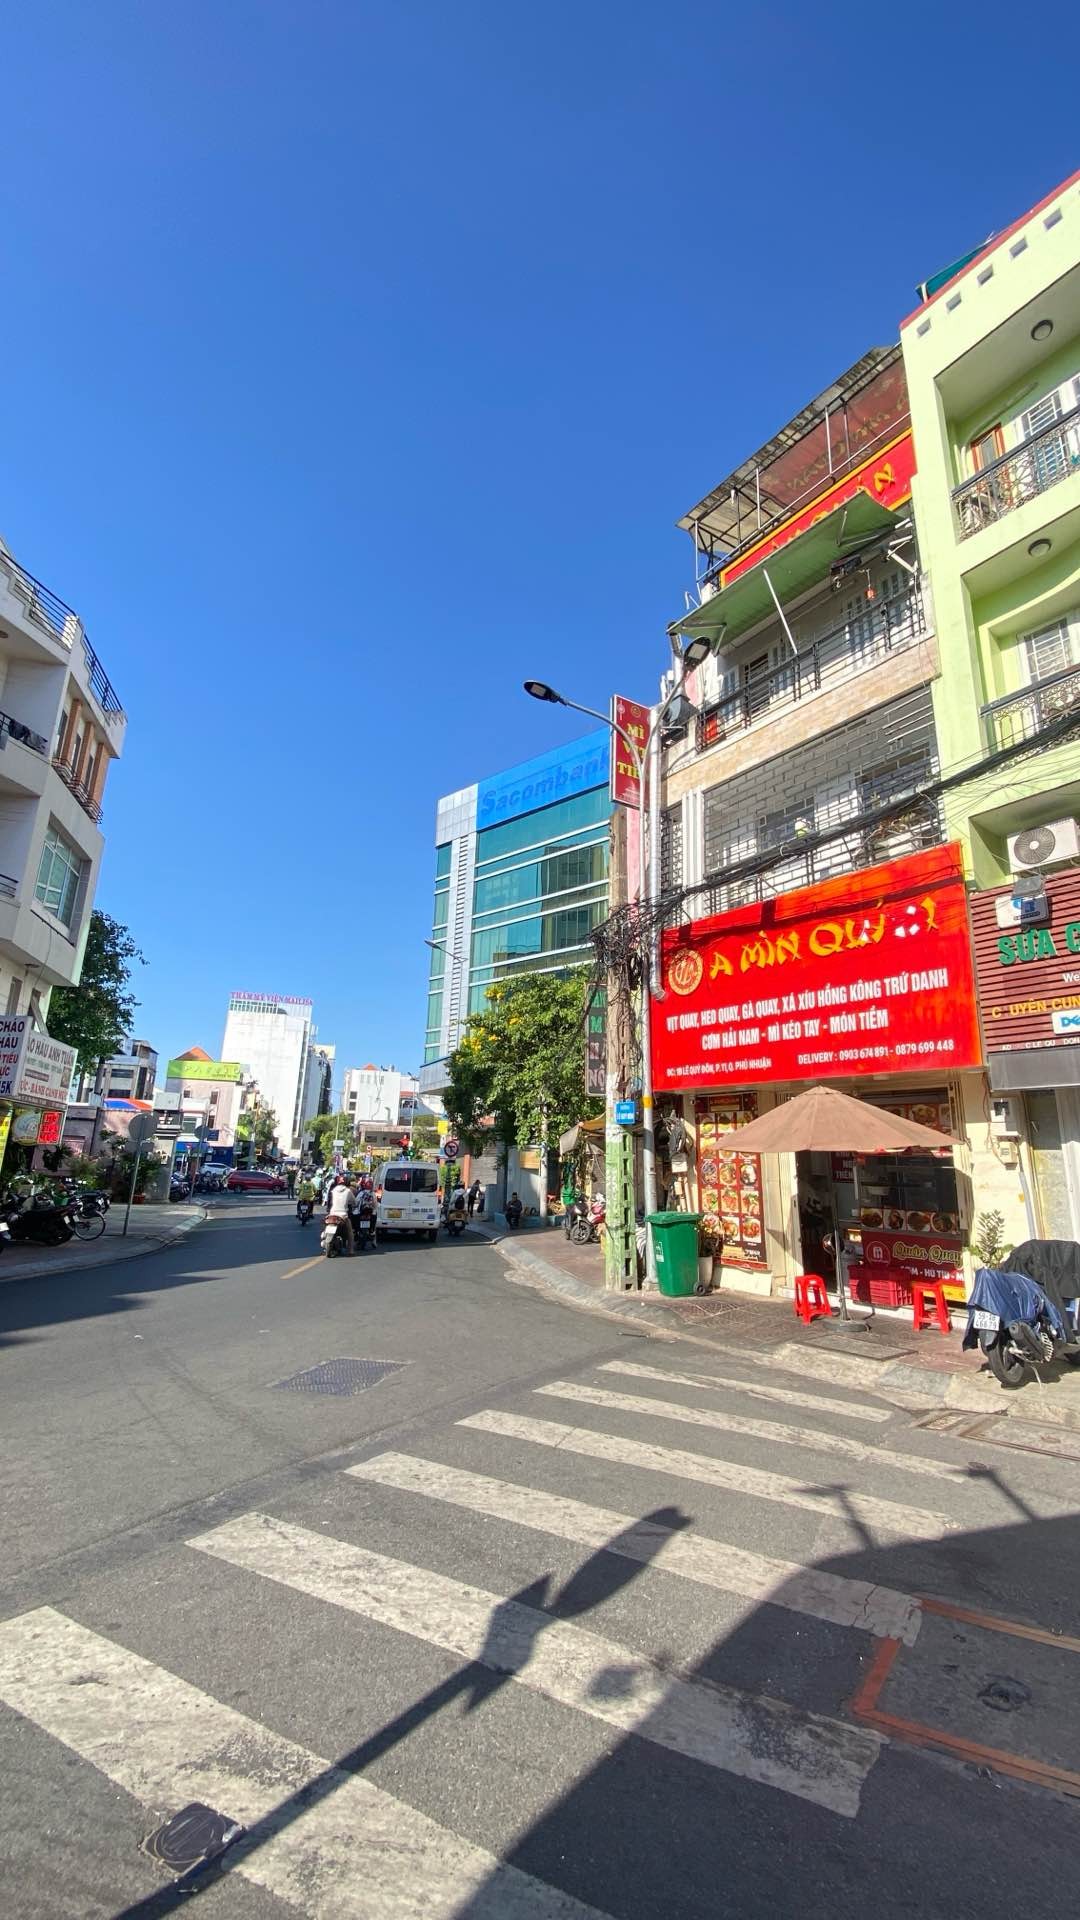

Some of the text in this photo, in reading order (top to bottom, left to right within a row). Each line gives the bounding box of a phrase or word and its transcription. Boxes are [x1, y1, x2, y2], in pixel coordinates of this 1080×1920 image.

[666, 1015, 679, 1033] VỊT
[701, 1009, 717, 1026] HEO
[742, 1000, 755, 1020] GÀ
[782, 991, 796, 1013] XÁ
[798, 989, 815, 1010] XÍU
[850, 979, 882, 1002] KÔNG
[911, 968, 948, 991] DANH
[702, 1034, 721, 1051] CƠM
[739, 1028, 760, 1046] NAM
[768, 1022, 781, 1043] MÌ
[782, 1019, 802, 1040] KÉO
[803, 1019, 821, 1037] TAY
[830, 1011, 857, 1034] MÓN
[798, 1051, 834, 1065] DELIVERY
[839, 1048, 858, 1061] 0903
[895, 1043, 916, 1055] 0879
[918, 1041, 935, 1054] 699
[936, 1039, 955, 1051] 448
